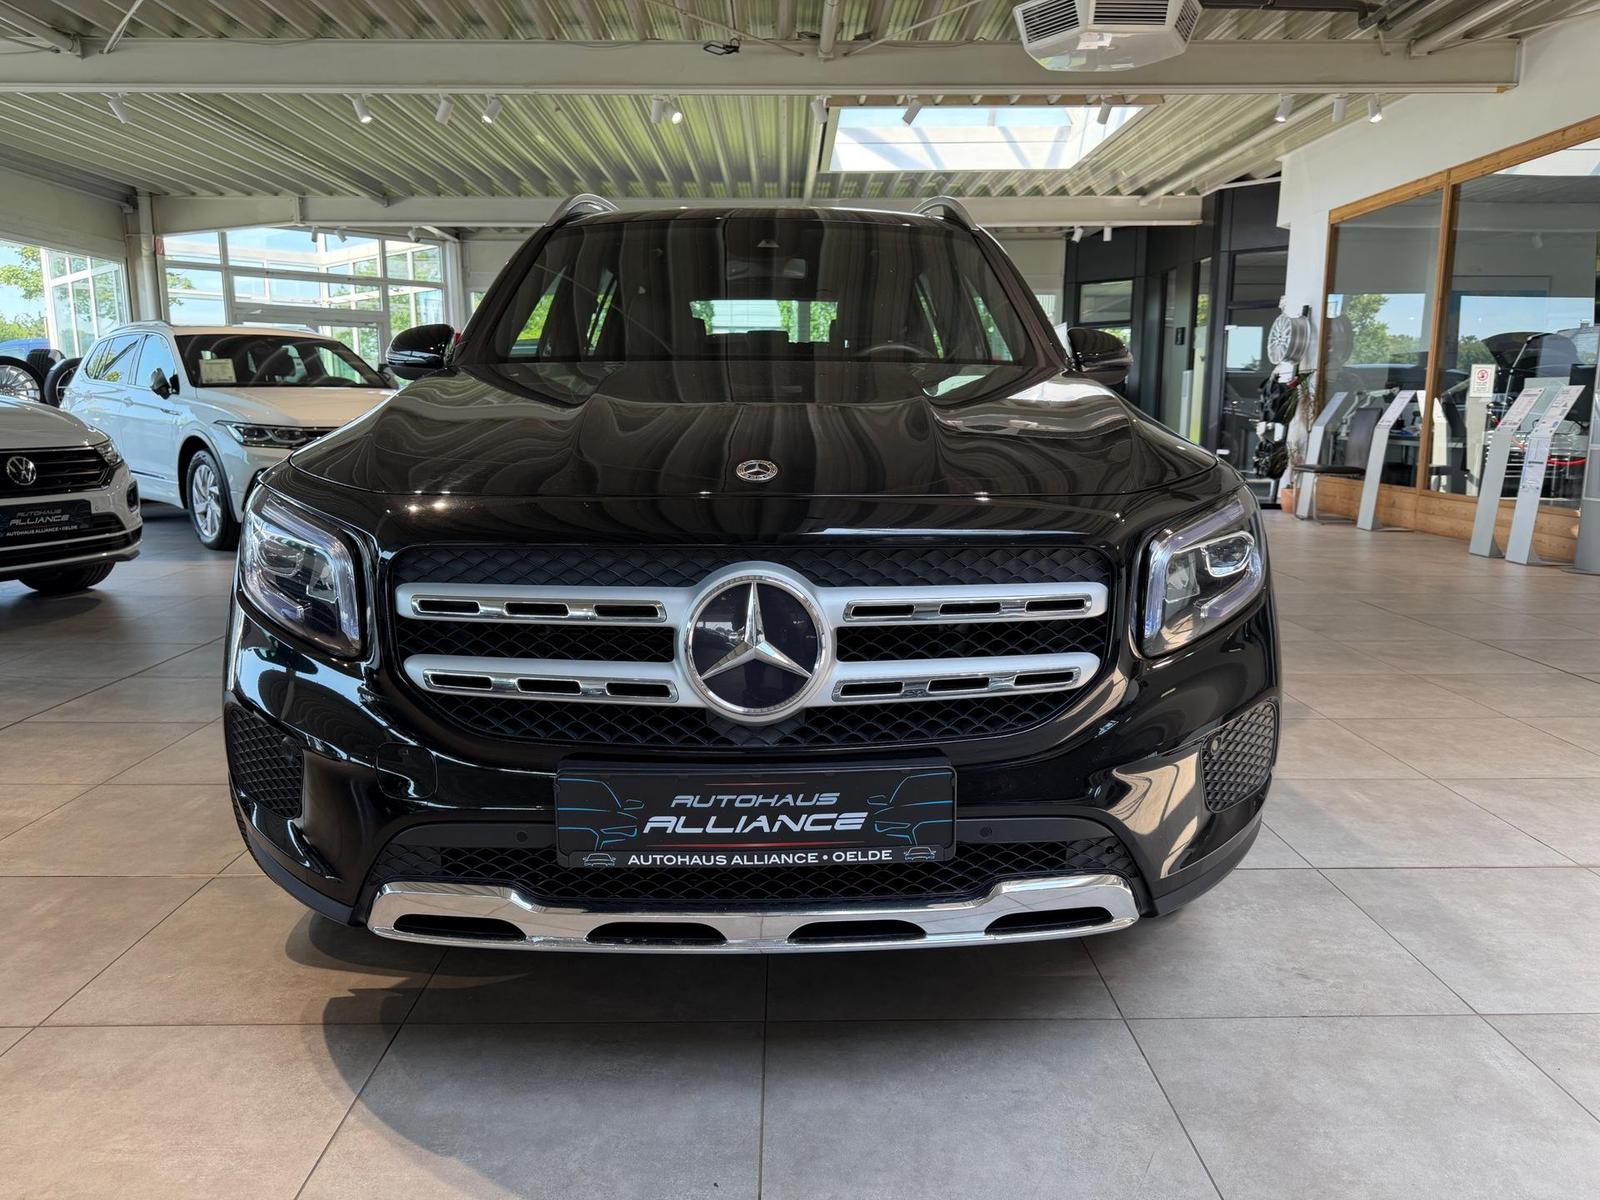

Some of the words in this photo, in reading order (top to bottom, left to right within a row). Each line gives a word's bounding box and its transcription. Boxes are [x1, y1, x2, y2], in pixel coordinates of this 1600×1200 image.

[9, 514, 70, 526] ALLIANCE
[670, 792, 841, 808] AUTOHAUS
[642, 811, 869, 834] ALLIANCE
[627, 854, 728, 866] AUTOHAUS
[730, 852, 819, 866] ALLIANCE
[832, 849, 893, 863] OELDE
